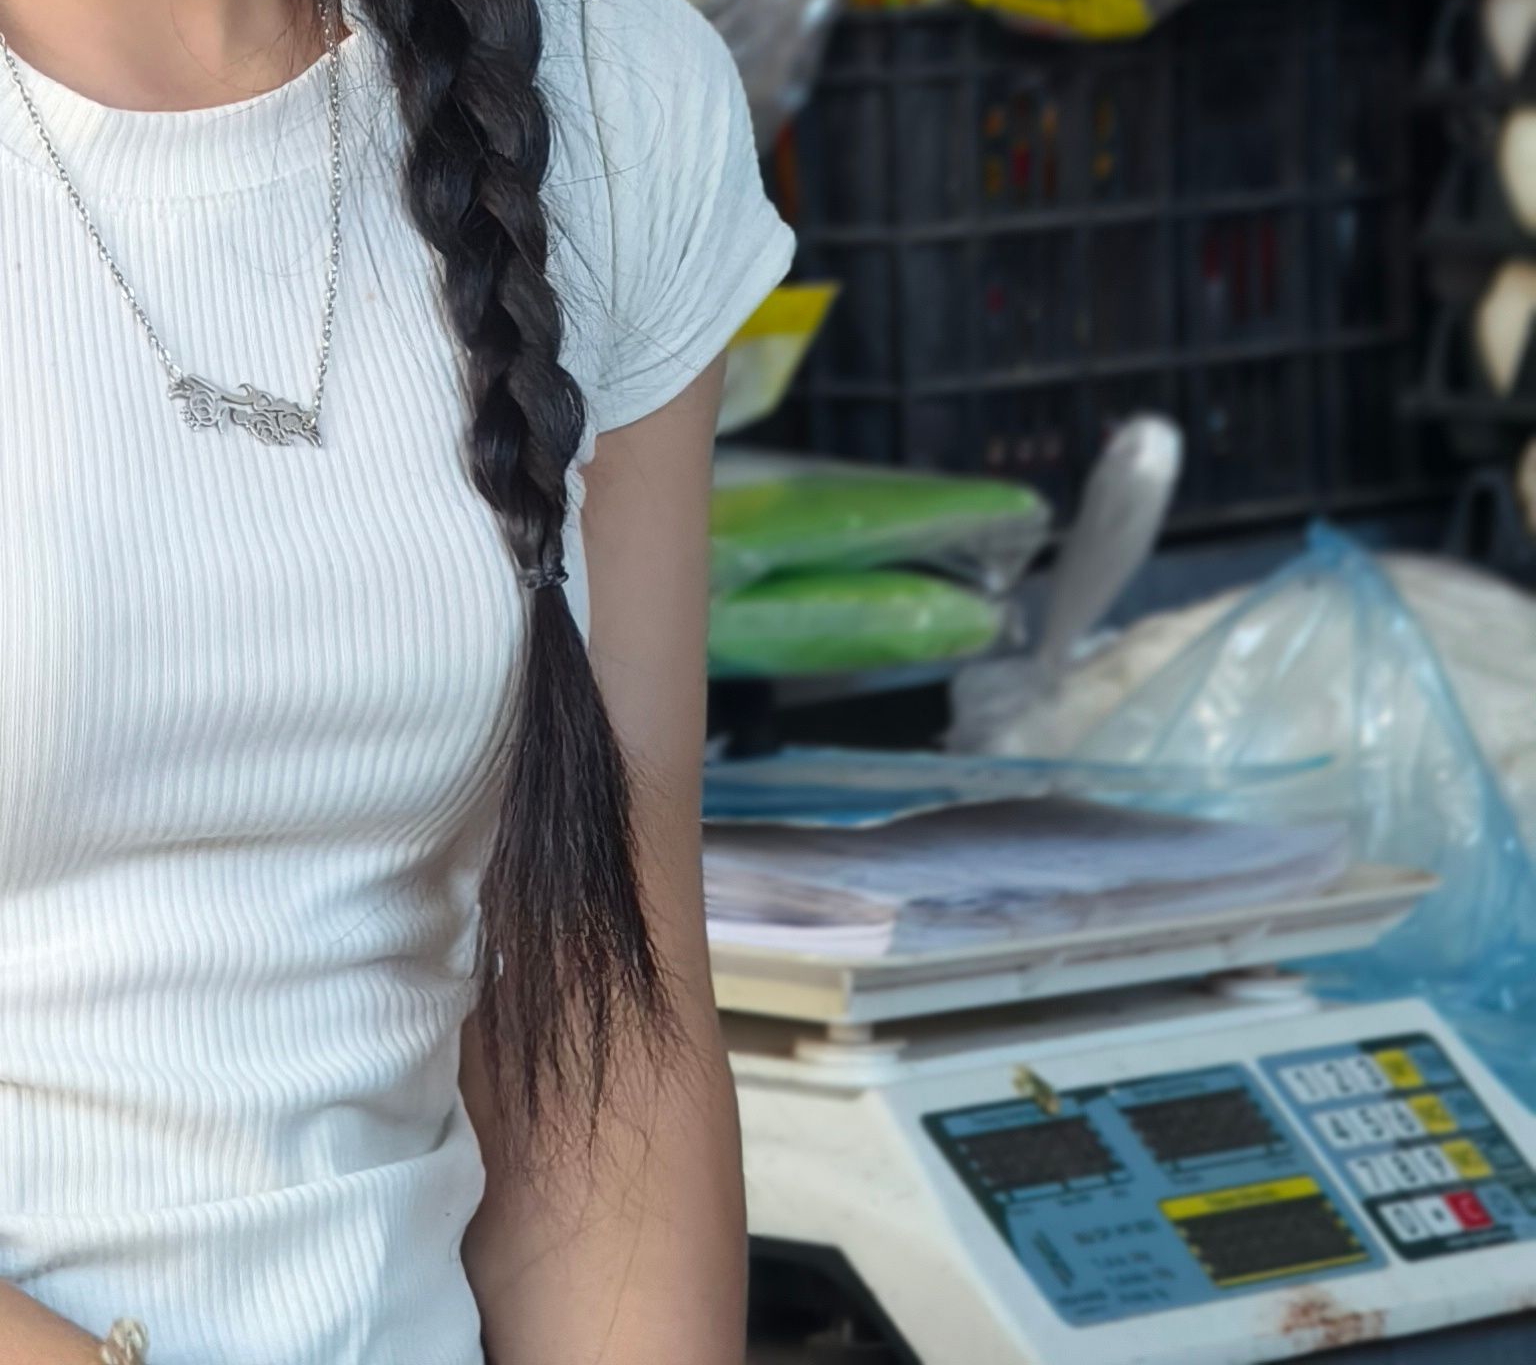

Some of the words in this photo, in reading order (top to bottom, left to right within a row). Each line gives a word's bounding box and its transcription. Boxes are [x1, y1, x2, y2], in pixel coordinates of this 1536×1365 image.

[1324, 1063, 1351, 1093] 2
[1354, 1057, 1383, 1088] 3
[1357, 1107, 1384, 1138] 5
[1391, 1101, 1417, 1132] 6
[1356, 1159, 1383, 1190] 7
